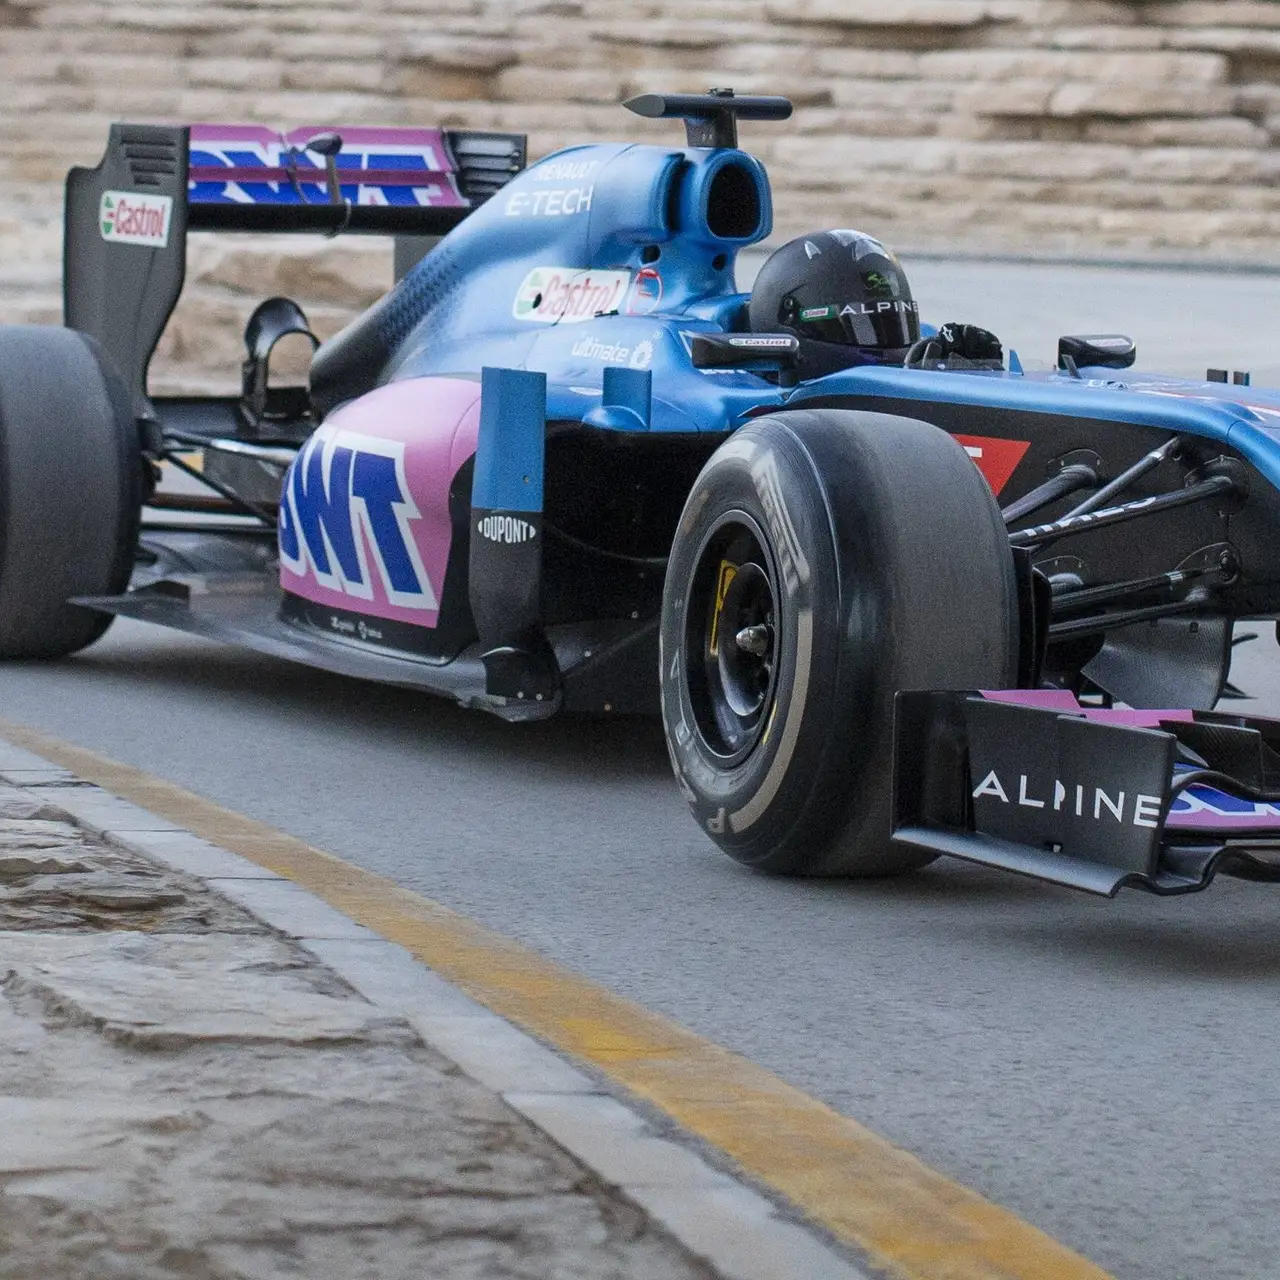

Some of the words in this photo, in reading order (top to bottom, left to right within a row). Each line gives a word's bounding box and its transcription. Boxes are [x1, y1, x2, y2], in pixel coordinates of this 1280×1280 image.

[505, 184, 594, 216] E-TECH
[116, 199, 166, 238] Castrol
[536, 273, 621, 316] Castrol
[840, 300, 919, 316] ALPINE
[571, 333, 630, 363] ultimate
[483, 516, 529, 544] DUPONT
[972, 770, 1162, 829] ALPINE
